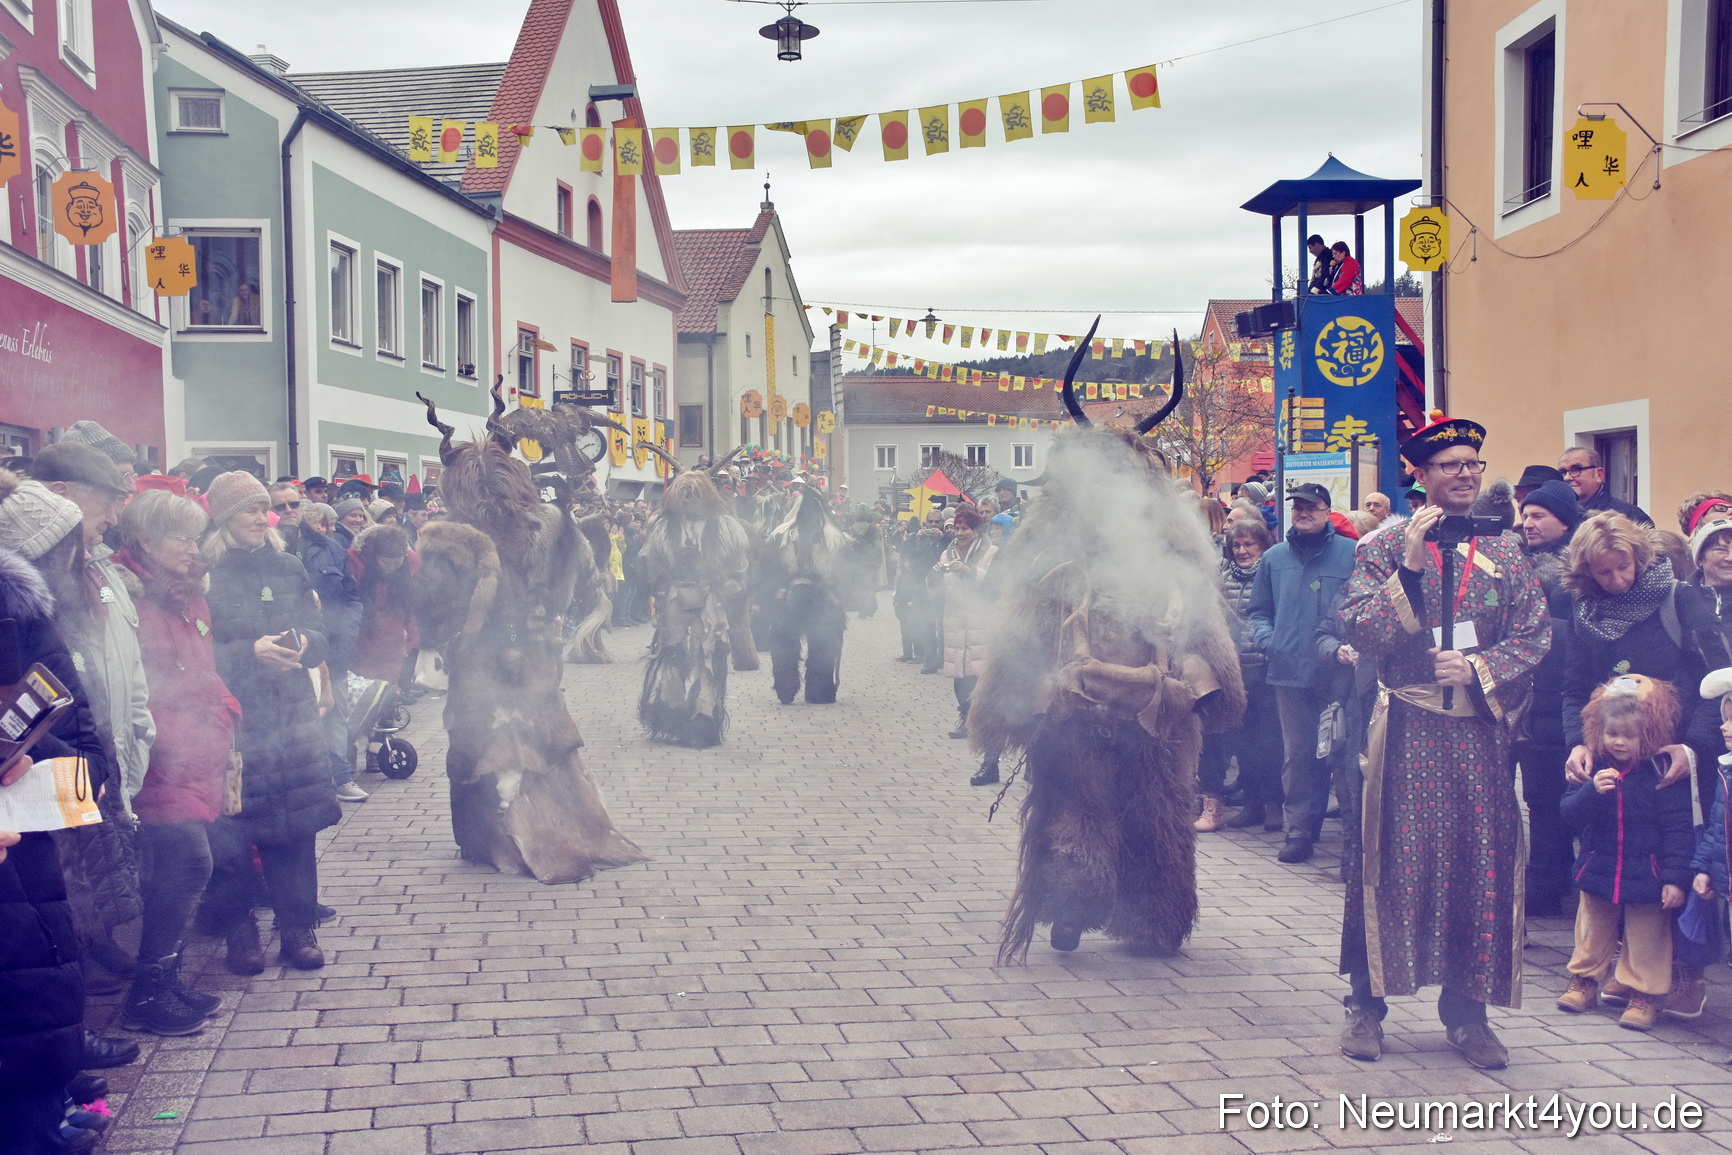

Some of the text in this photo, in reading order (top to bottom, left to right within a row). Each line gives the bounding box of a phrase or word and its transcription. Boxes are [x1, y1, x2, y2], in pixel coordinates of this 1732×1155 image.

[21, 321, 53, 364] Erlebnis
[560, 392, 609, 400] RÖHLICH
[1285, 460, 1312, 469] DIETFURTER
[1312, 458, 1345, 467] WASSERWEGE
